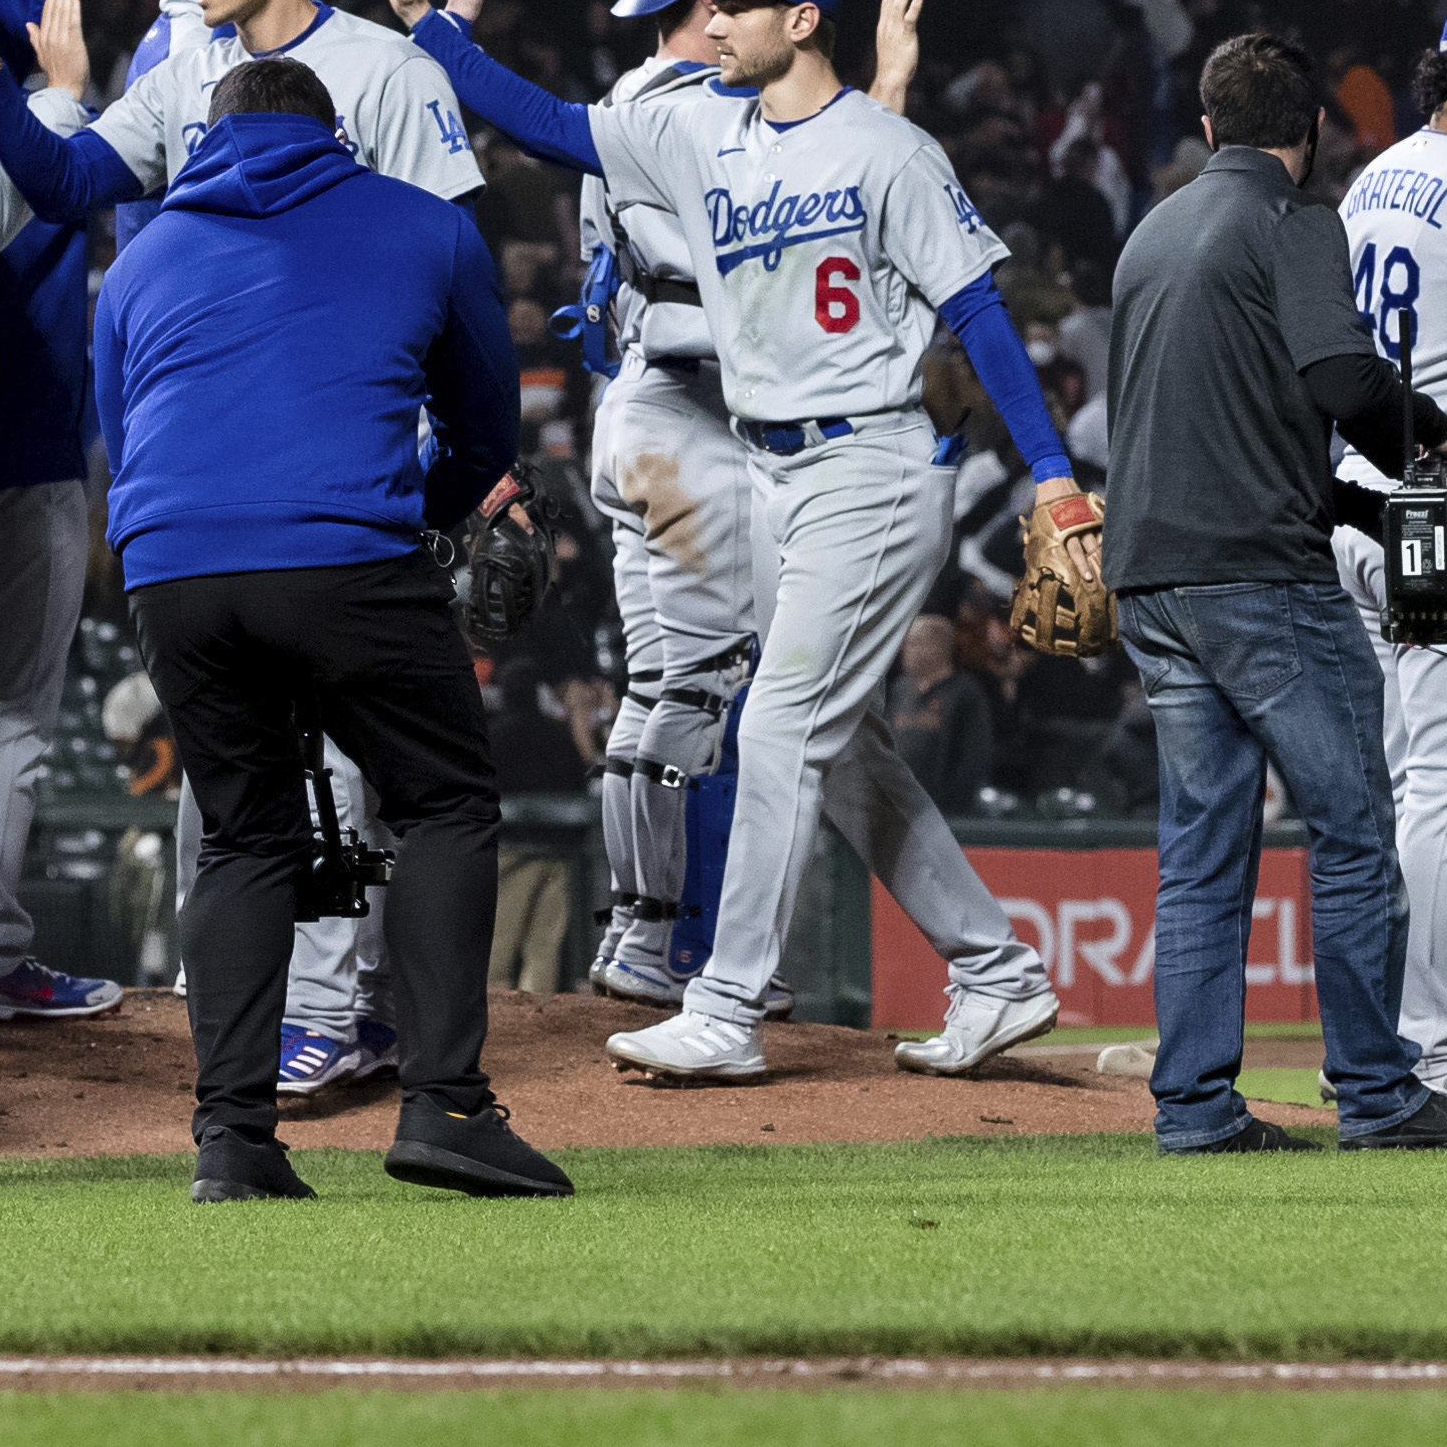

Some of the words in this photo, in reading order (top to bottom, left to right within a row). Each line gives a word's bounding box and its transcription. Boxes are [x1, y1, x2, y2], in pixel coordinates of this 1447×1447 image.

[705, 179, 867, 274] Dodgers
[815, 257, 861, 334] 6
[1353, 242, 1420, 360] 48
[1406, 542, 1415, 572] 1
